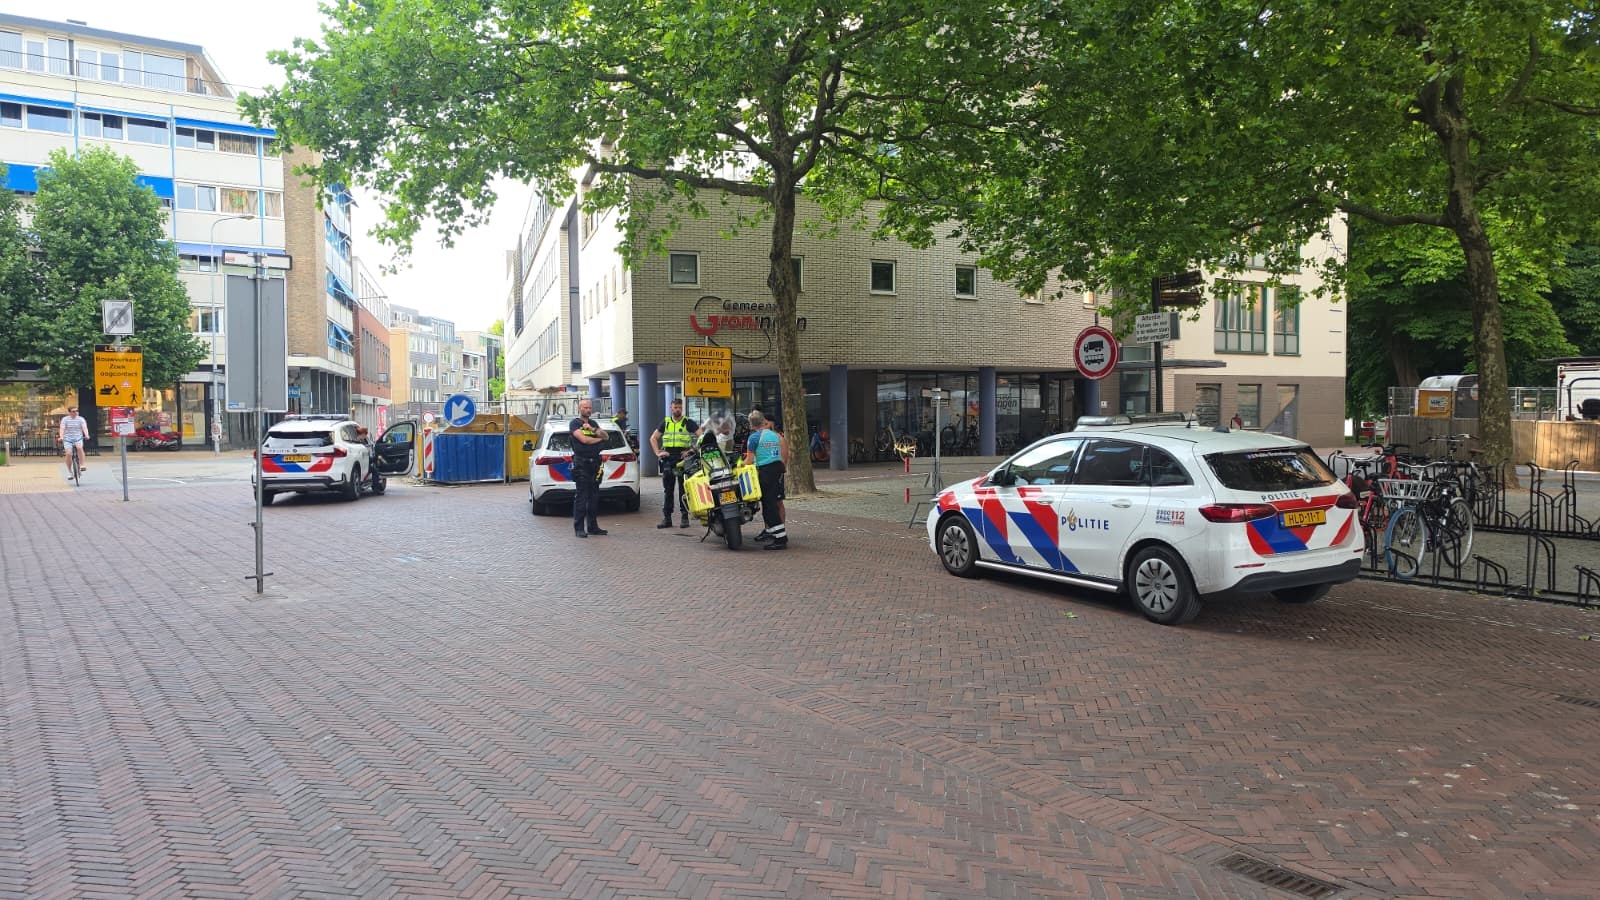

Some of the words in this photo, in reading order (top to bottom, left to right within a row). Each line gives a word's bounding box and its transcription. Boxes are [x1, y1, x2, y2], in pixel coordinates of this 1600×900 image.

[722, 299, 778, 312] Gemeen
[690, 299, 807, 335] Groninn
[686, 349, 725, 358] Omleiding
[686, 359, 716, 367] Verkeer
[686, 375, 718, 383] Centrum
[1260, 491, 1300, 502] POLITIE
[1171, 510, 1185, 520] 112
[1288, 511, 1321, 525] HLD-11-T
[1061, 514, 1109, 532] POLITIE
